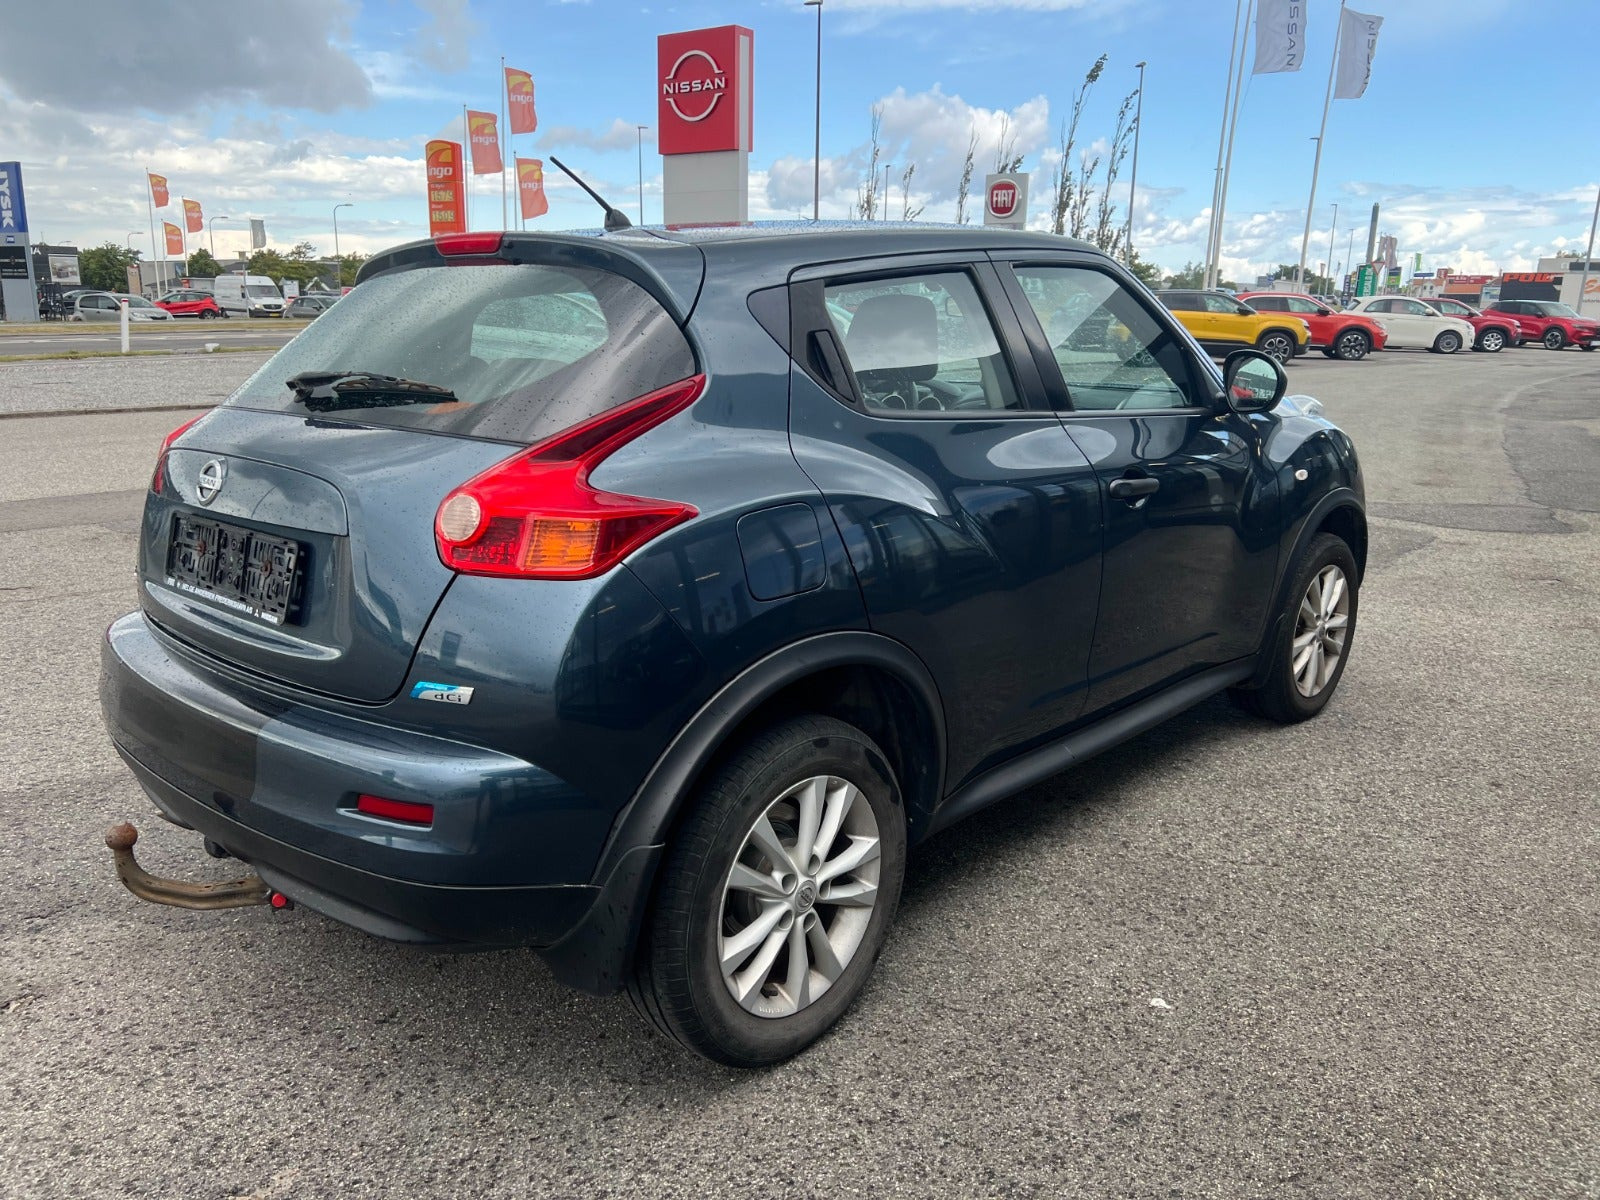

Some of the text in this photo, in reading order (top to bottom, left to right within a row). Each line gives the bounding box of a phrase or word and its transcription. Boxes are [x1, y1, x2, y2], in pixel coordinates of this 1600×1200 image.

[663, 77, 725, 94] NISSAN
[510, 92, 533, 105] ingo
[472, 134, 497, 146] ingo
[428, 166, 453, 179] ingo
[992, 189, 1014, 208] FIAT
[434, 693, 462, 702] dCi
